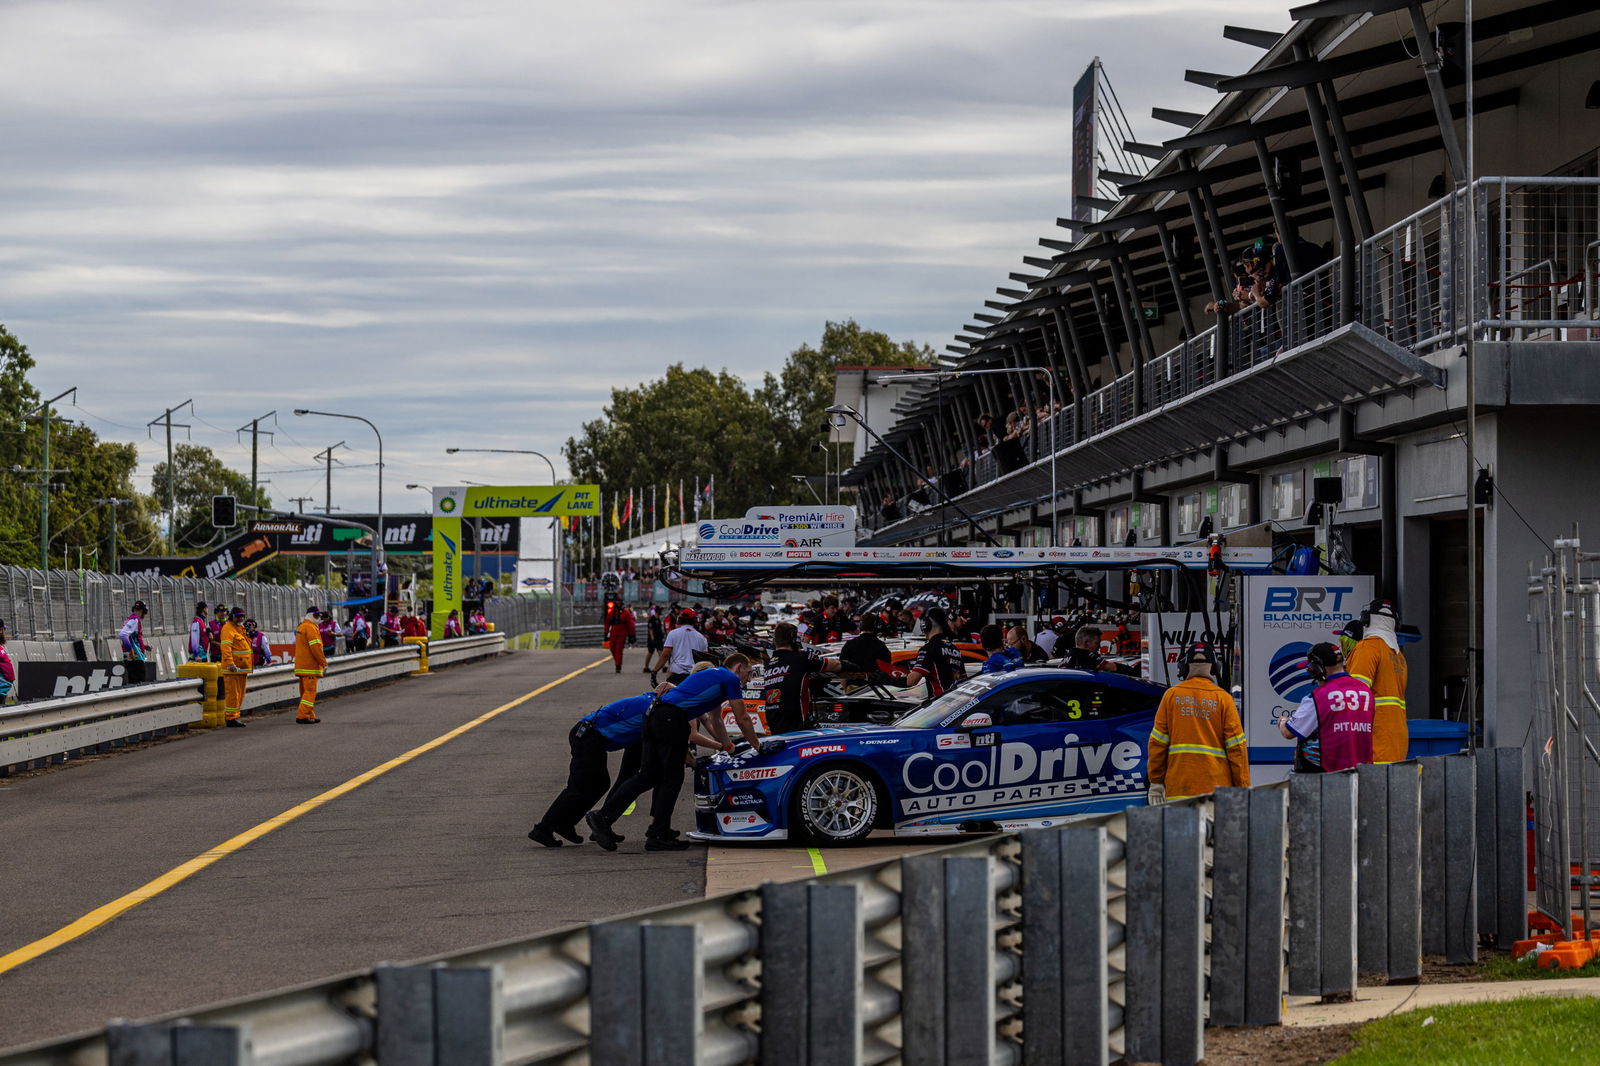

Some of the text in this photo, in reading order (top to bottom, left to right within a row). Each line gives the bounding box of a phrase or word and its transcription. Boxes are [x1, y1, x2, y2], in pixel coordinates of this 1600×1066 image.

[474, 496, 538, 509] ultimate
[567, 501, 594, 509] LANE
[778, 512, 845, 522] PremiAir Hire
[384, 523, 417, 543] nti
[480, 523, 511, 543] nti
[719, 524, 780, 535] CoolDrive
[206, 548, 234, 578] nti
[685, 553, 726, 561] HAZELWOOD
[443, 552, 453, 601] ultimate
[1264, 587, 1353, 612] BRT
[1264, 613, 1353, 621] BLANCHARD
[53, 664, 125, 696] nti
[1175, 695, 1218, 711] RURAL FIRE
[1327, 690, 1371, 711] 337
[1067, 699, 1082, 719] 3
[1181, 706, 1211, 720] SERVICE
[1333, 722, 1372, 733] PIT LANE
[976, 733, 995, 746] nti
[801, 745, 844, 758] MOTUL
[902, 733, 1142, 794] CoolDrive
[739, 768, 777, 780] LOCTITE
[801, 780, 812, 822] DUNLOP
[908, 782, 1077, 812] AUTO PARTS
